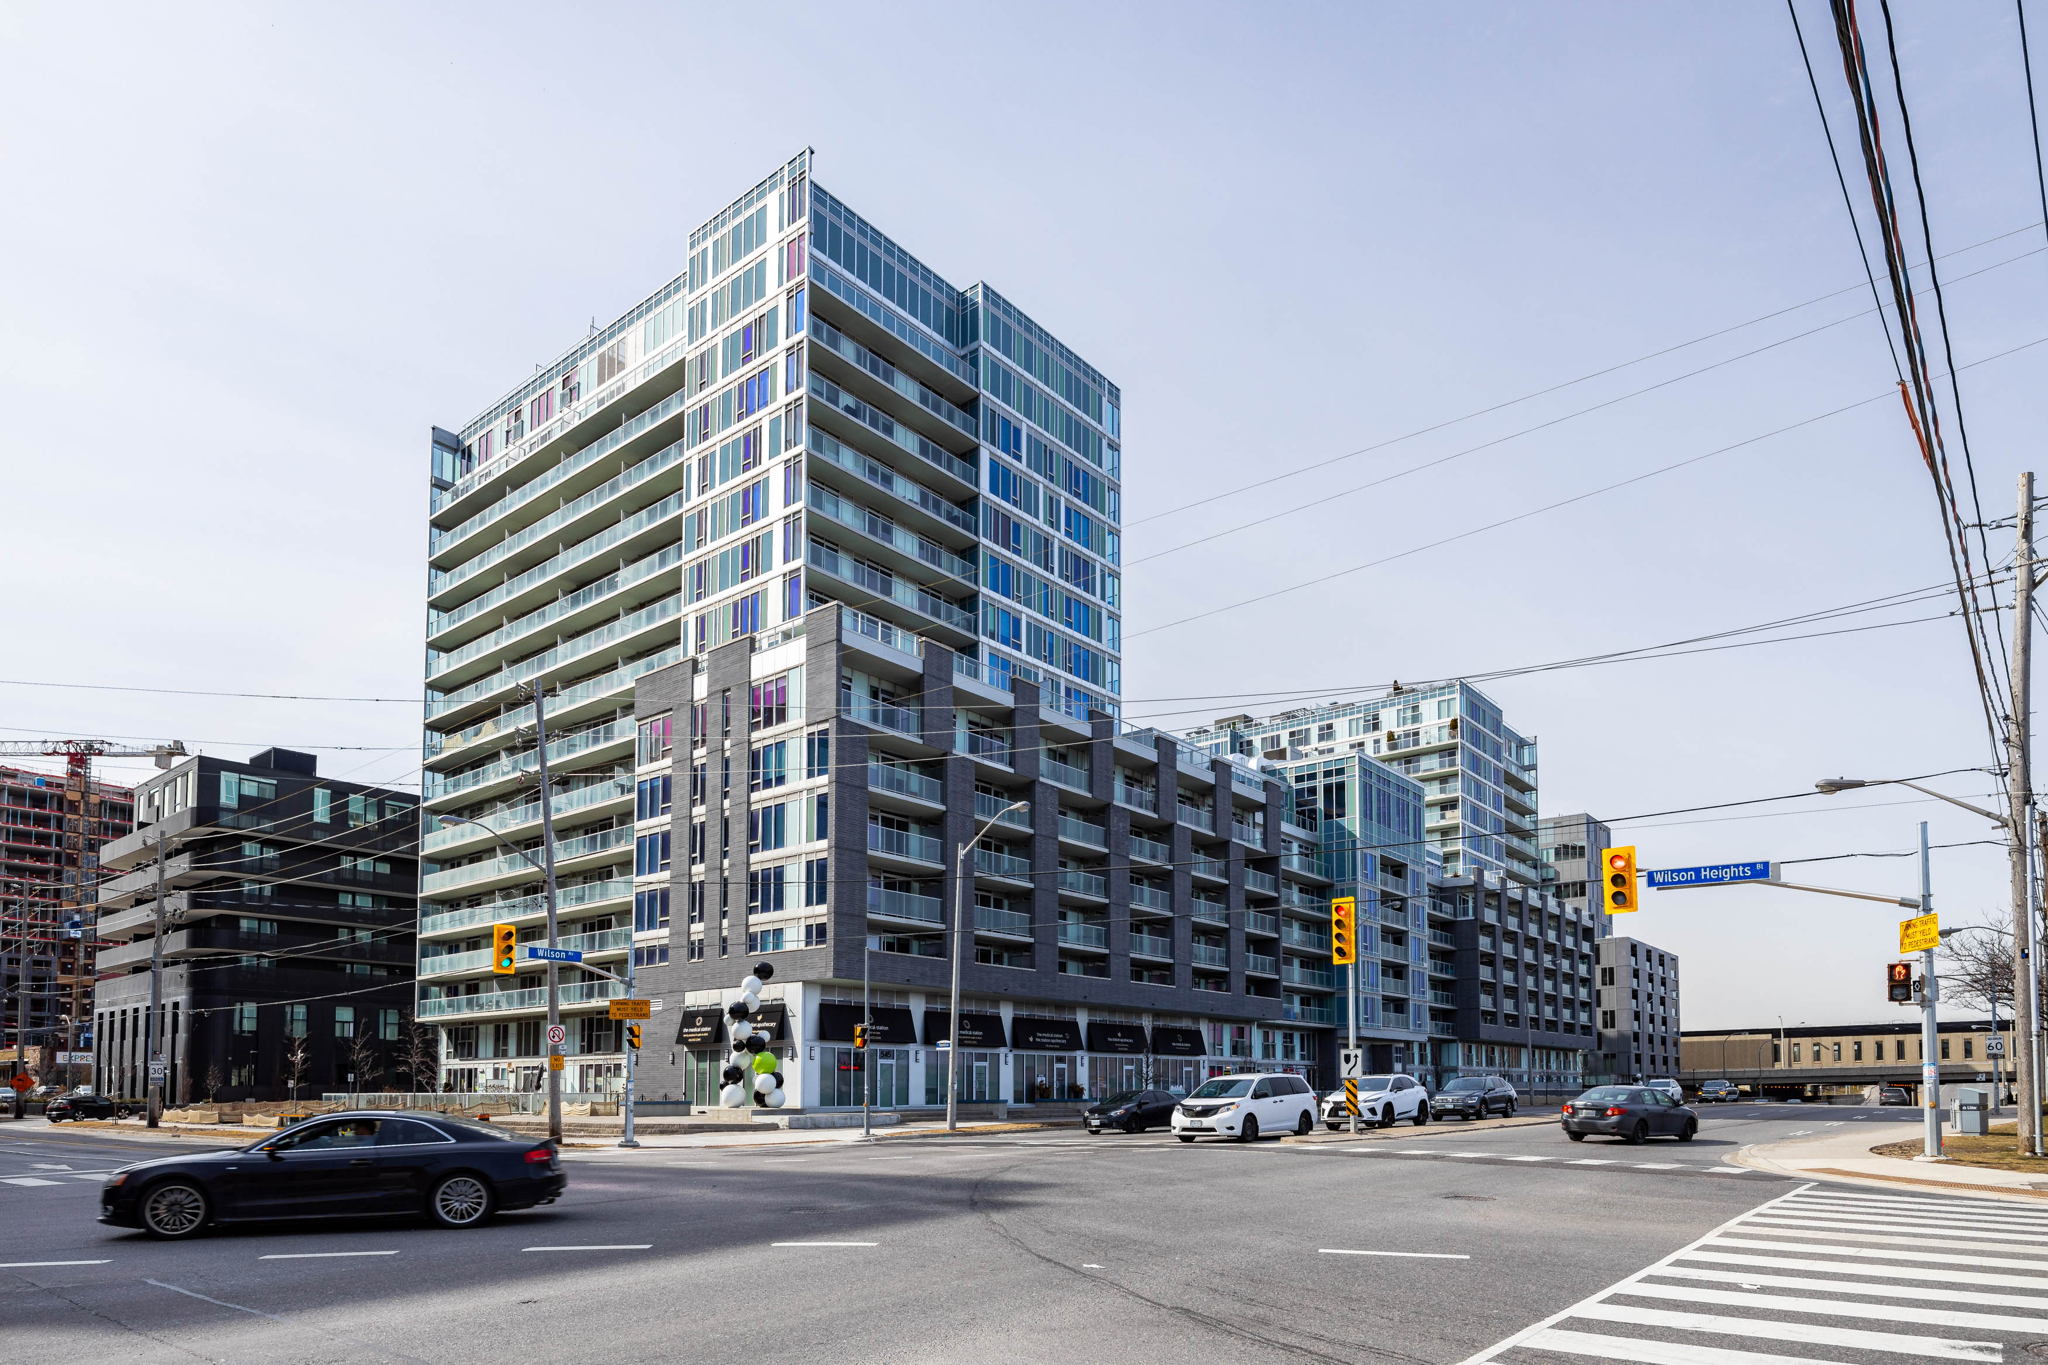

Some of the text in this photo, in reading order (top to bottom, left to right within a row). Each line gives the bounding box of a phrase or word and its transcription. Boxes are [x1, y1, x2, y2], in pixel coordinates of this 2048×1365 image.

[1653, 870, 1695, 883] Wilson
[1701, 865, 1752, 881] Heights
[537, 948, 566, 959] Wilson
[1987, 1041, 2003, 1051] 60
[151, 1067, 163, 1075] 30
